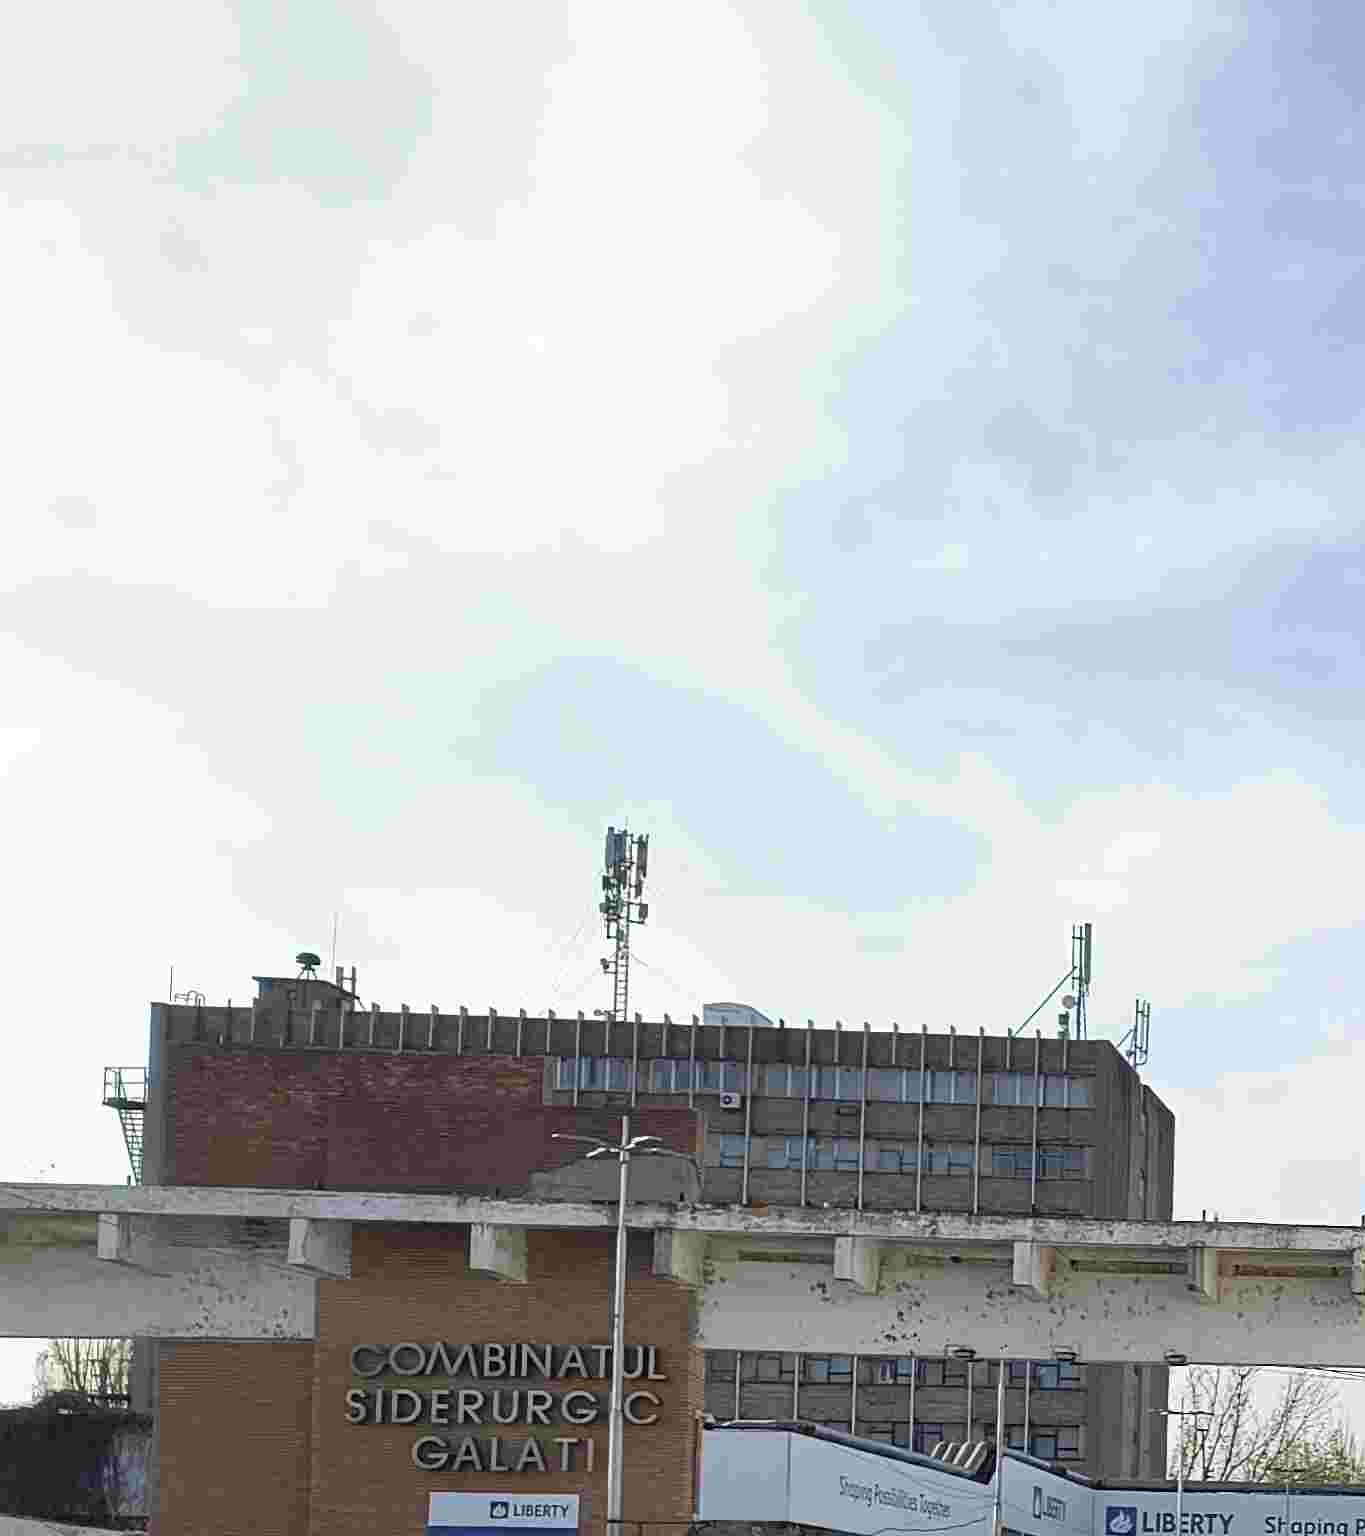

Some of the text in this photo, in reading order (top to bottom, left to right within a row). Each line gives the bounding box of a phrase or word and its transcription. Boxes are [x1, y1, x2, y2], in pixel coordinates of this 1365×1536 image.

[350, 1342, 667, 1379] COMBINATUL
[345, 1390, 662, 1424] SIDERURGC
[412, 1435, 594, 1473] GALATI
[513, 1504, 569, 1518] LIBERTY
[1142, 1511, 1235, 1535] LIBERTY
